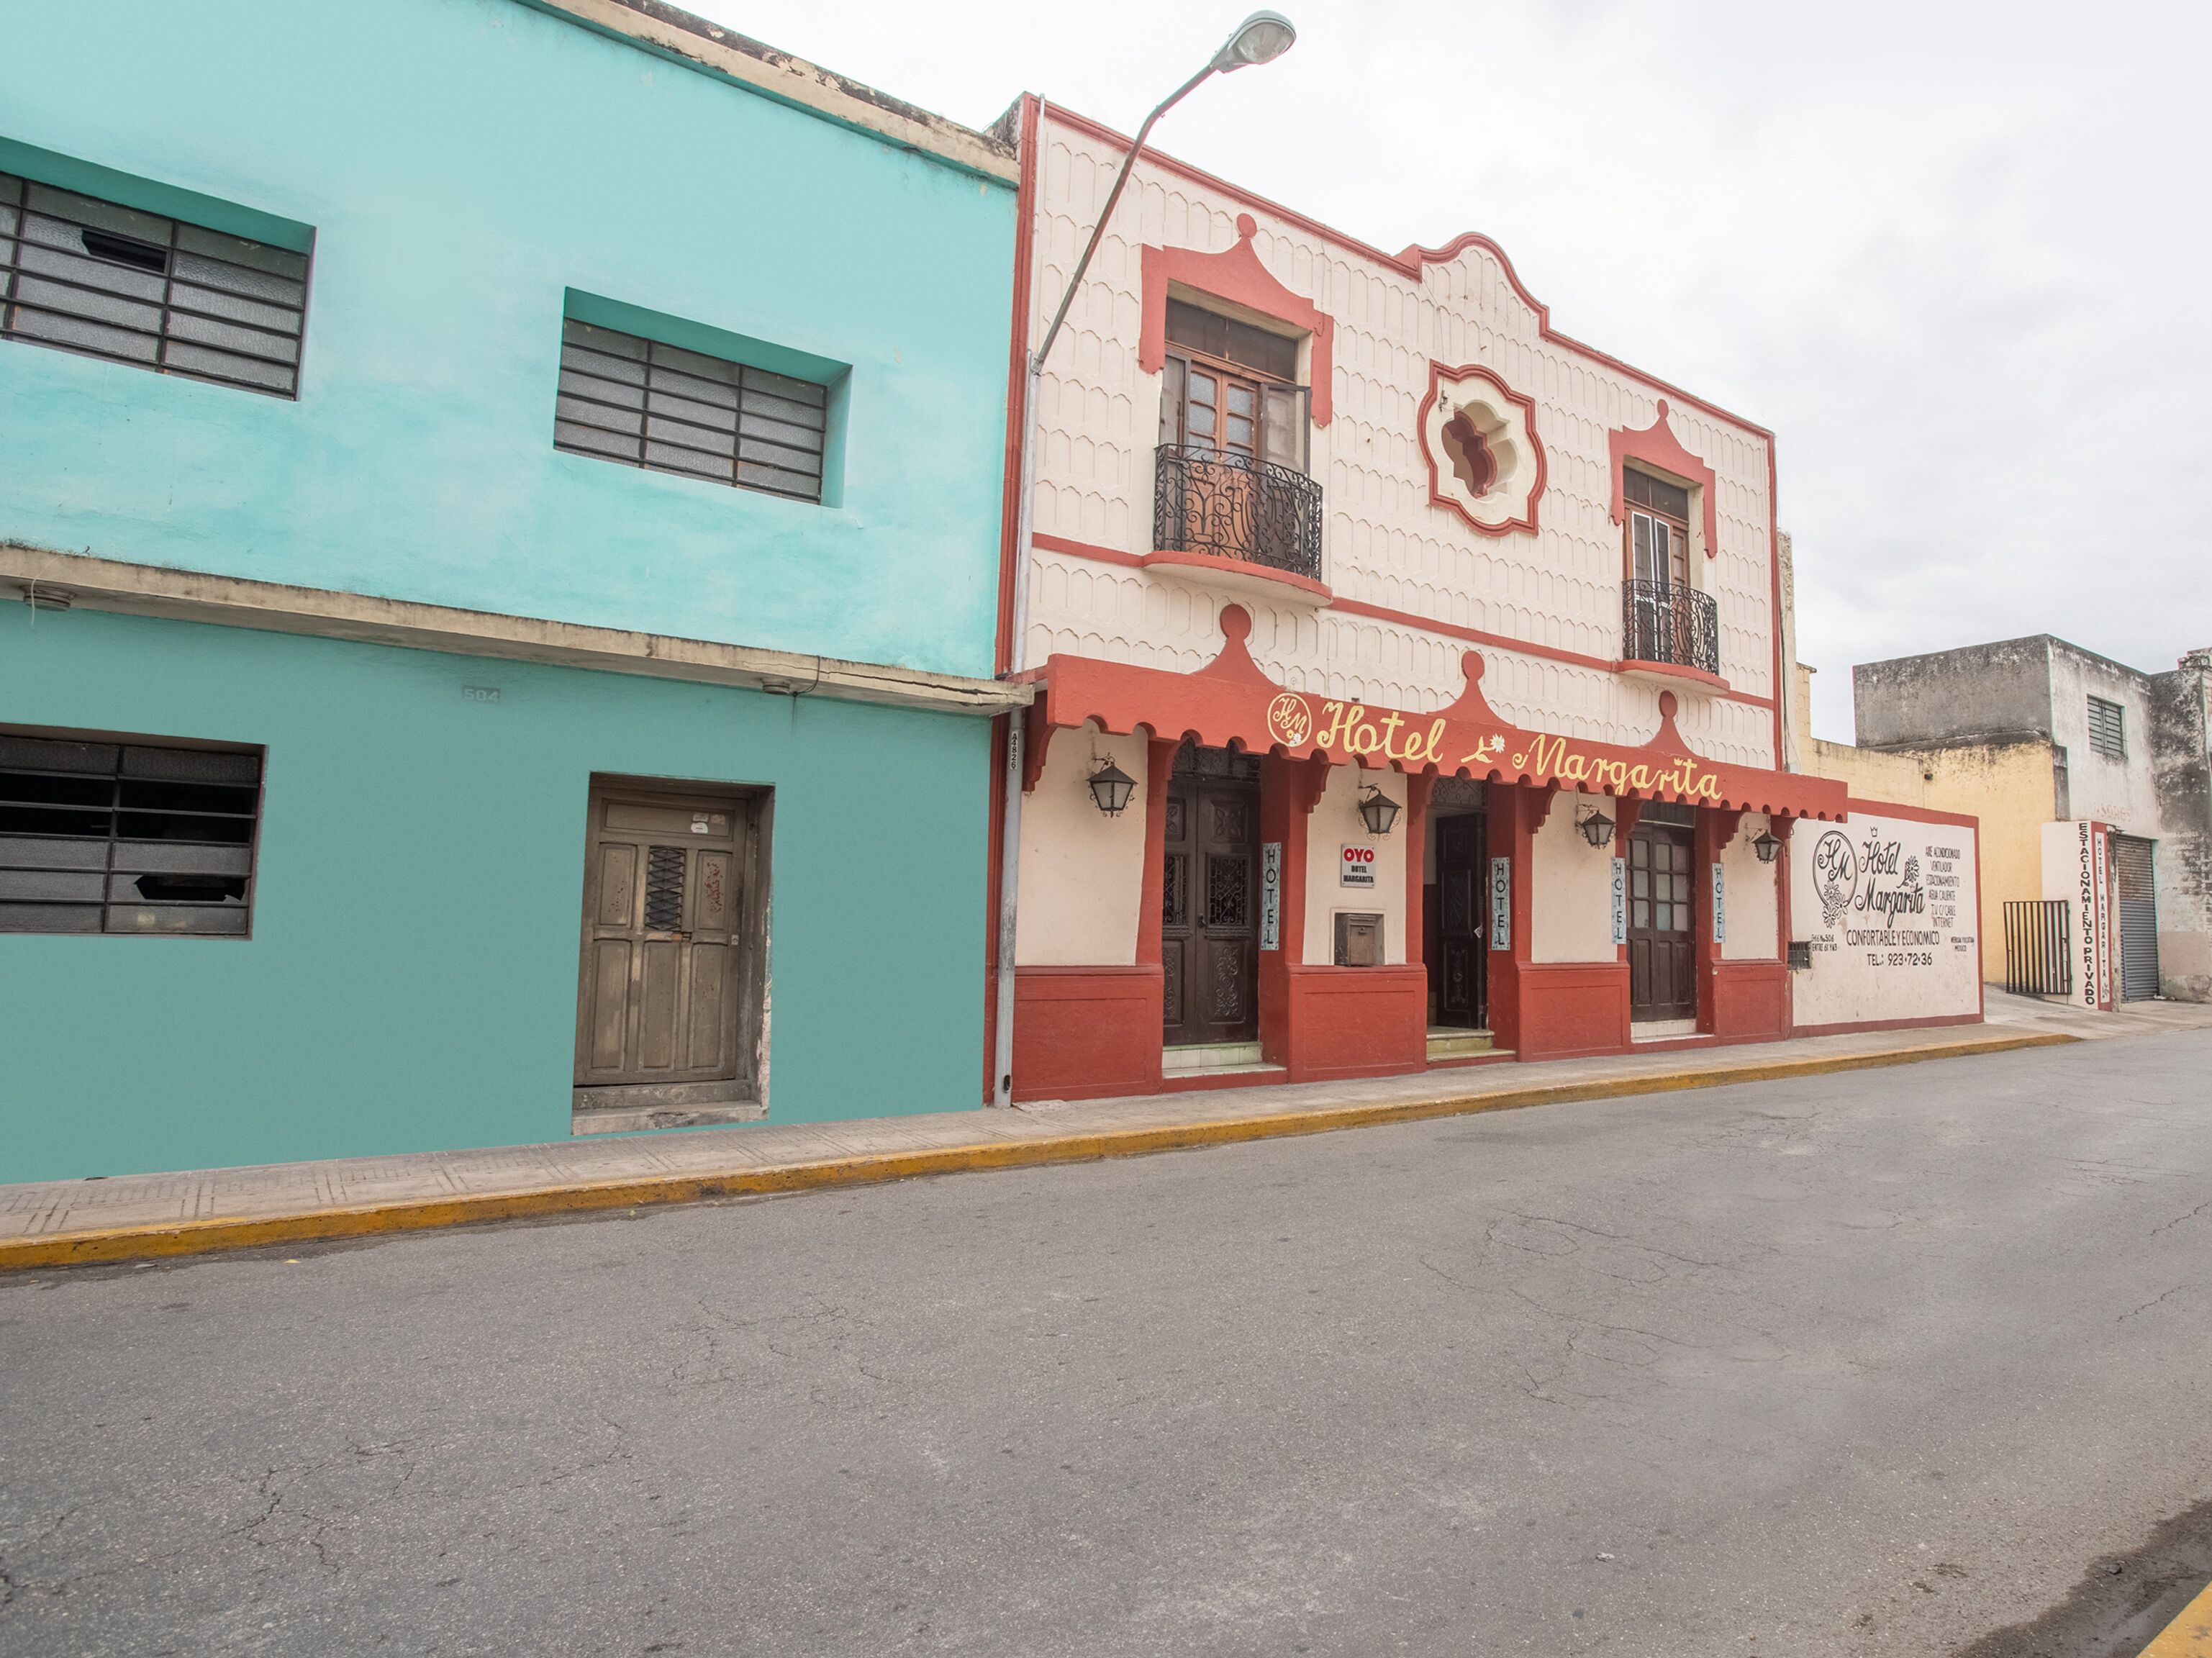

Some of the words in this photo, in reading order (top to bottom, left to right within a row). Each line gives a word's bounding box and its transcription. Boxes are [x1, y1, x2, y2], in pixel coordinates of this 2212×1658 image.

[464, 688, 499, 703] 504
[1316, 702, 1446, 763] Hotel
[1512, 733, 1722, 800] Margarita
[1343, 848, 1374, 863] OYO
[1351, 865, 1367, 874] HOTEL
[1859, 841, 1901, 875] Hotel
[1343, 874, 1374, 883] MARGARITA
[2079, 823, 2093, 944] ESTACIONAMIENTO
[1266, 848, 1277, 945] HOTEL
[1496, 863, 1506, 946] HOTEL
[1854, 876, 1926, 930] Margarita
[1846, 929, 1897, 946] CONFORTABLE
[1896, 930, 1901, 946] Y
[1902, 930, 1940, 946] ECONOMICO
[1931, 915, 1954, 928] INTERNET
[2084, 947, 2095, 1005] PRIVADO
